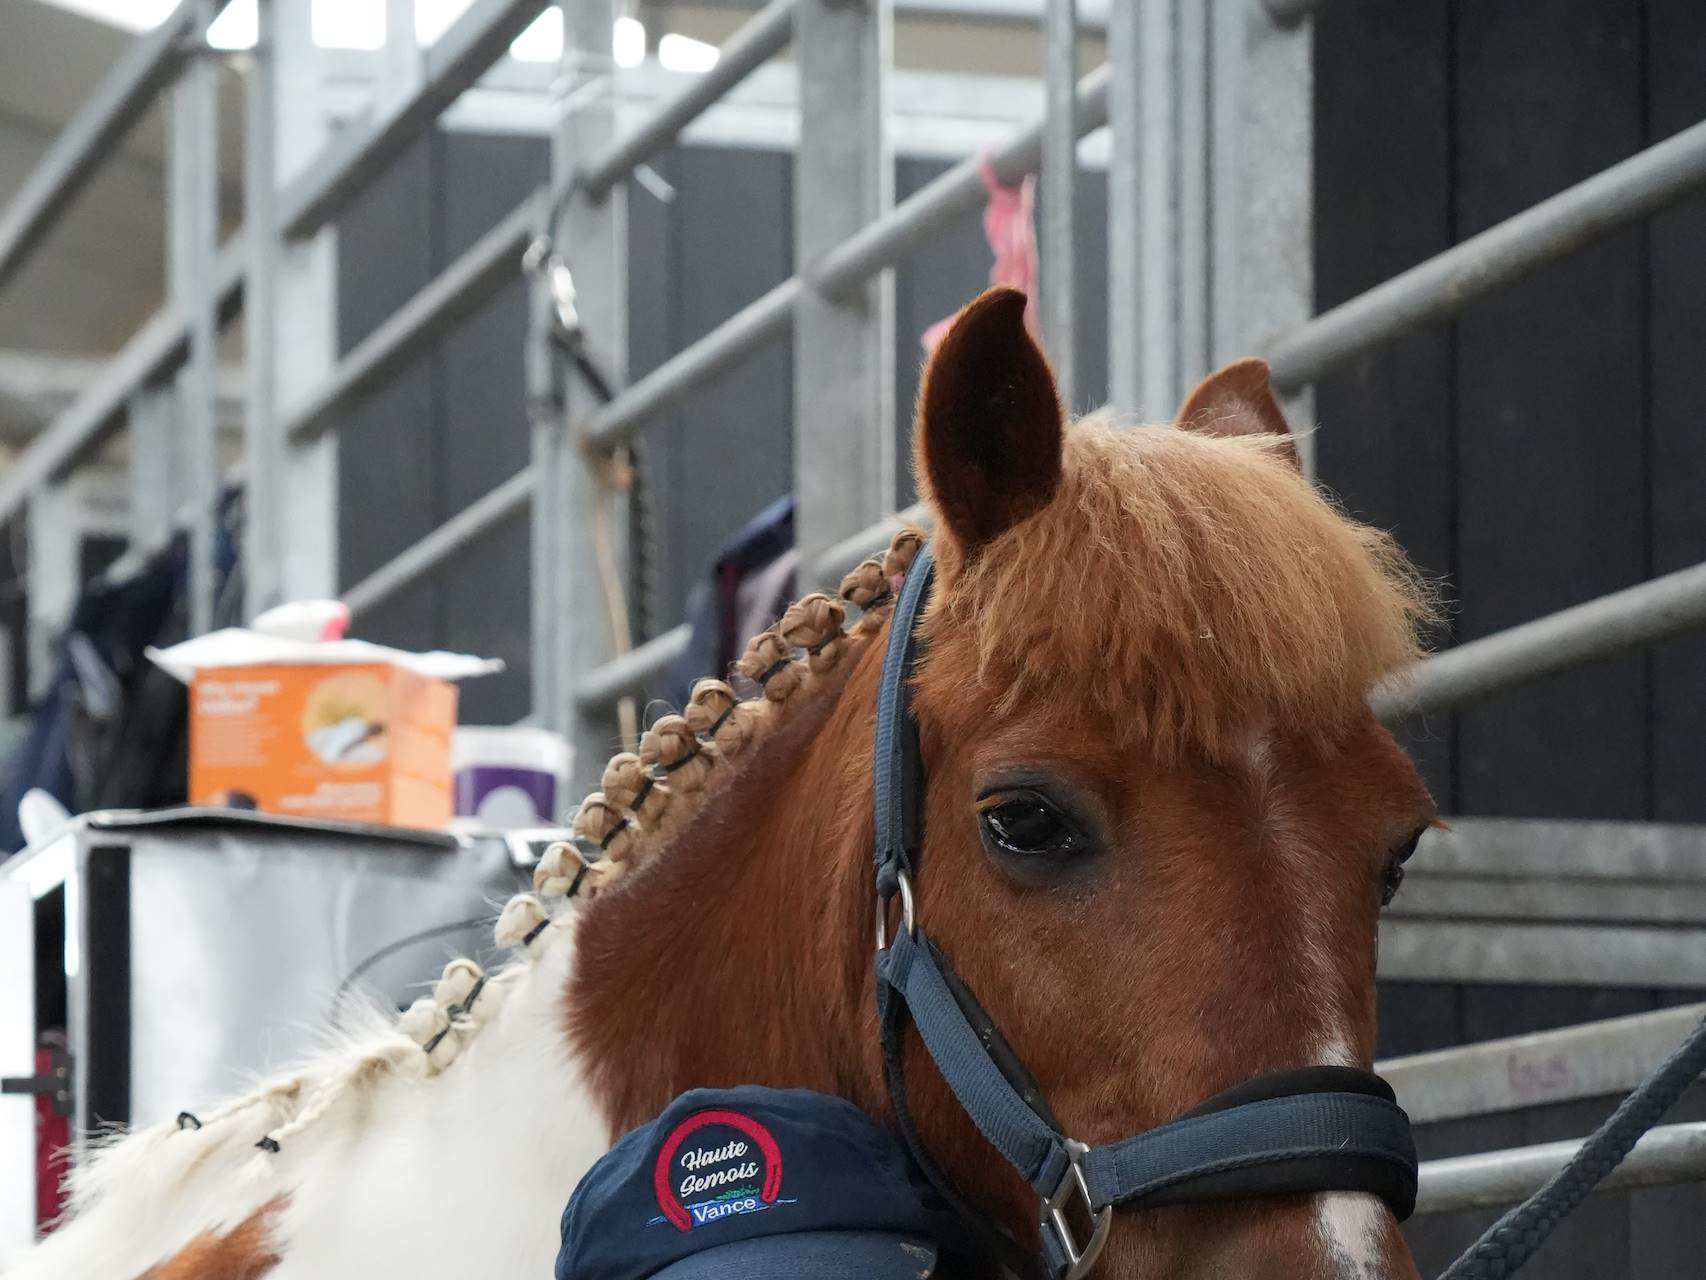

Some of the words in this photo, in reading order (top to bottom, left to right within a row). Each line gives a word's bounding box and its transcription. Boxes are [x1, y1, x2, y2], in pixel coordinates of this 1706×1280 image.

[681, 1141, 748, 1171] Haute
[680, 1162, 759, 1197] Semois
[693, 1198, 756, 1222] Vance
